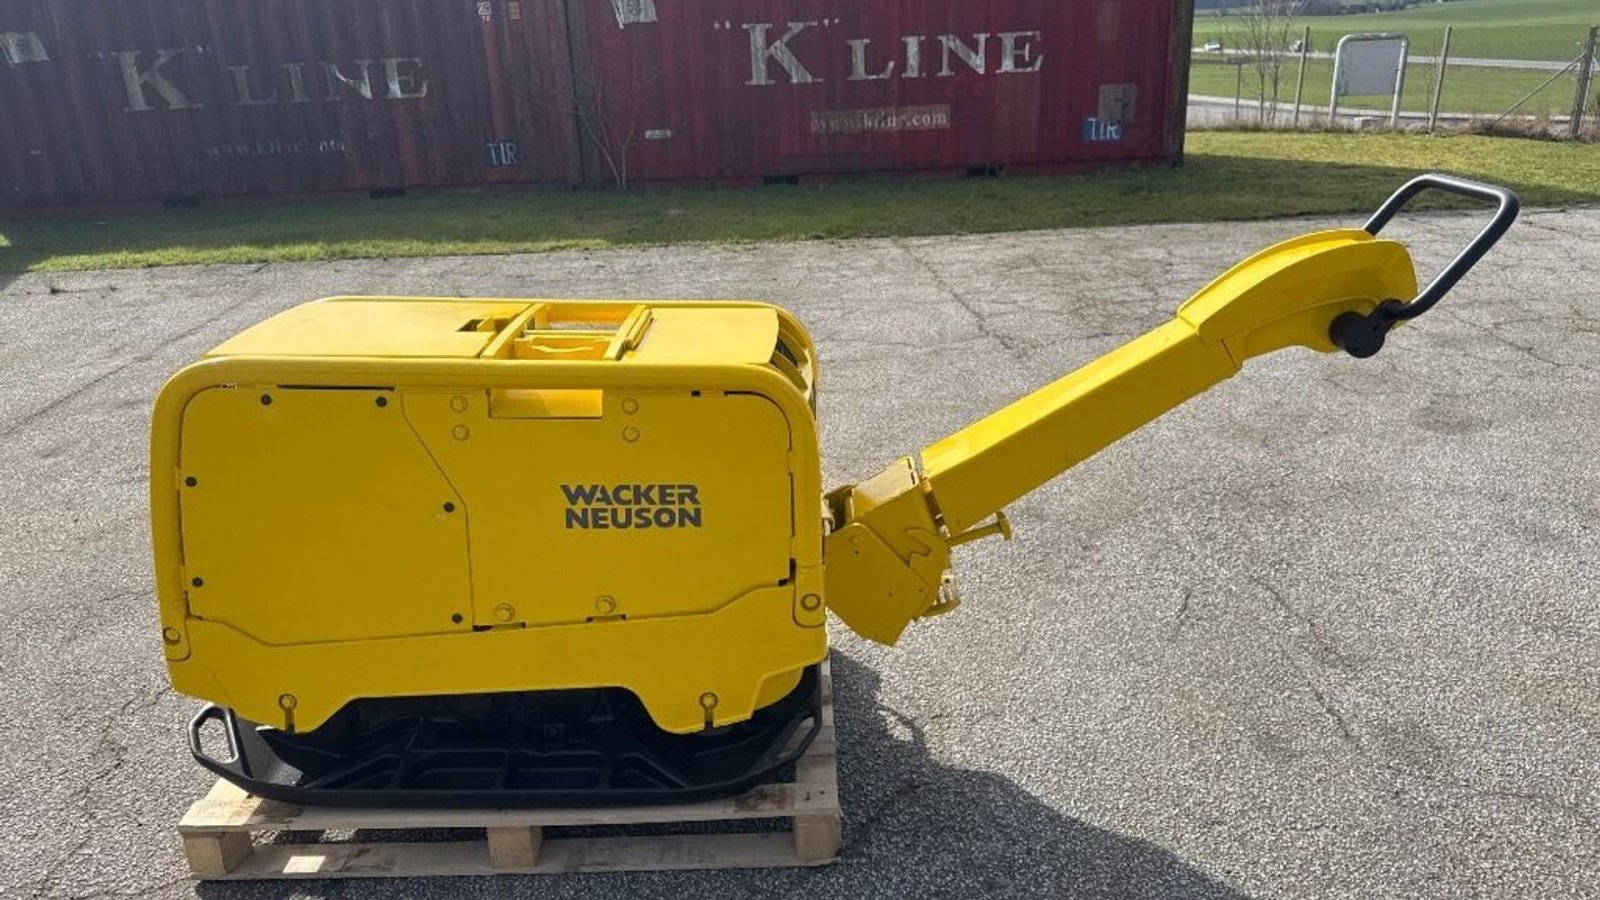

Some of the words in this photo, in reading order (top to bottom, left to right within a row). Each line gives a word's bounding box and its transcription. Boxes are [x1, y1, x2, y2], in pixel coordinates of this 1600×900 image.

[846, 30, 1044, 81] LINE
[227, 57, 428, 106] LINE
[487, 142, 518, 165] TIR
[560, 484, 701, 506] WACKER
[565, 508, 702, 529] NEUSON
